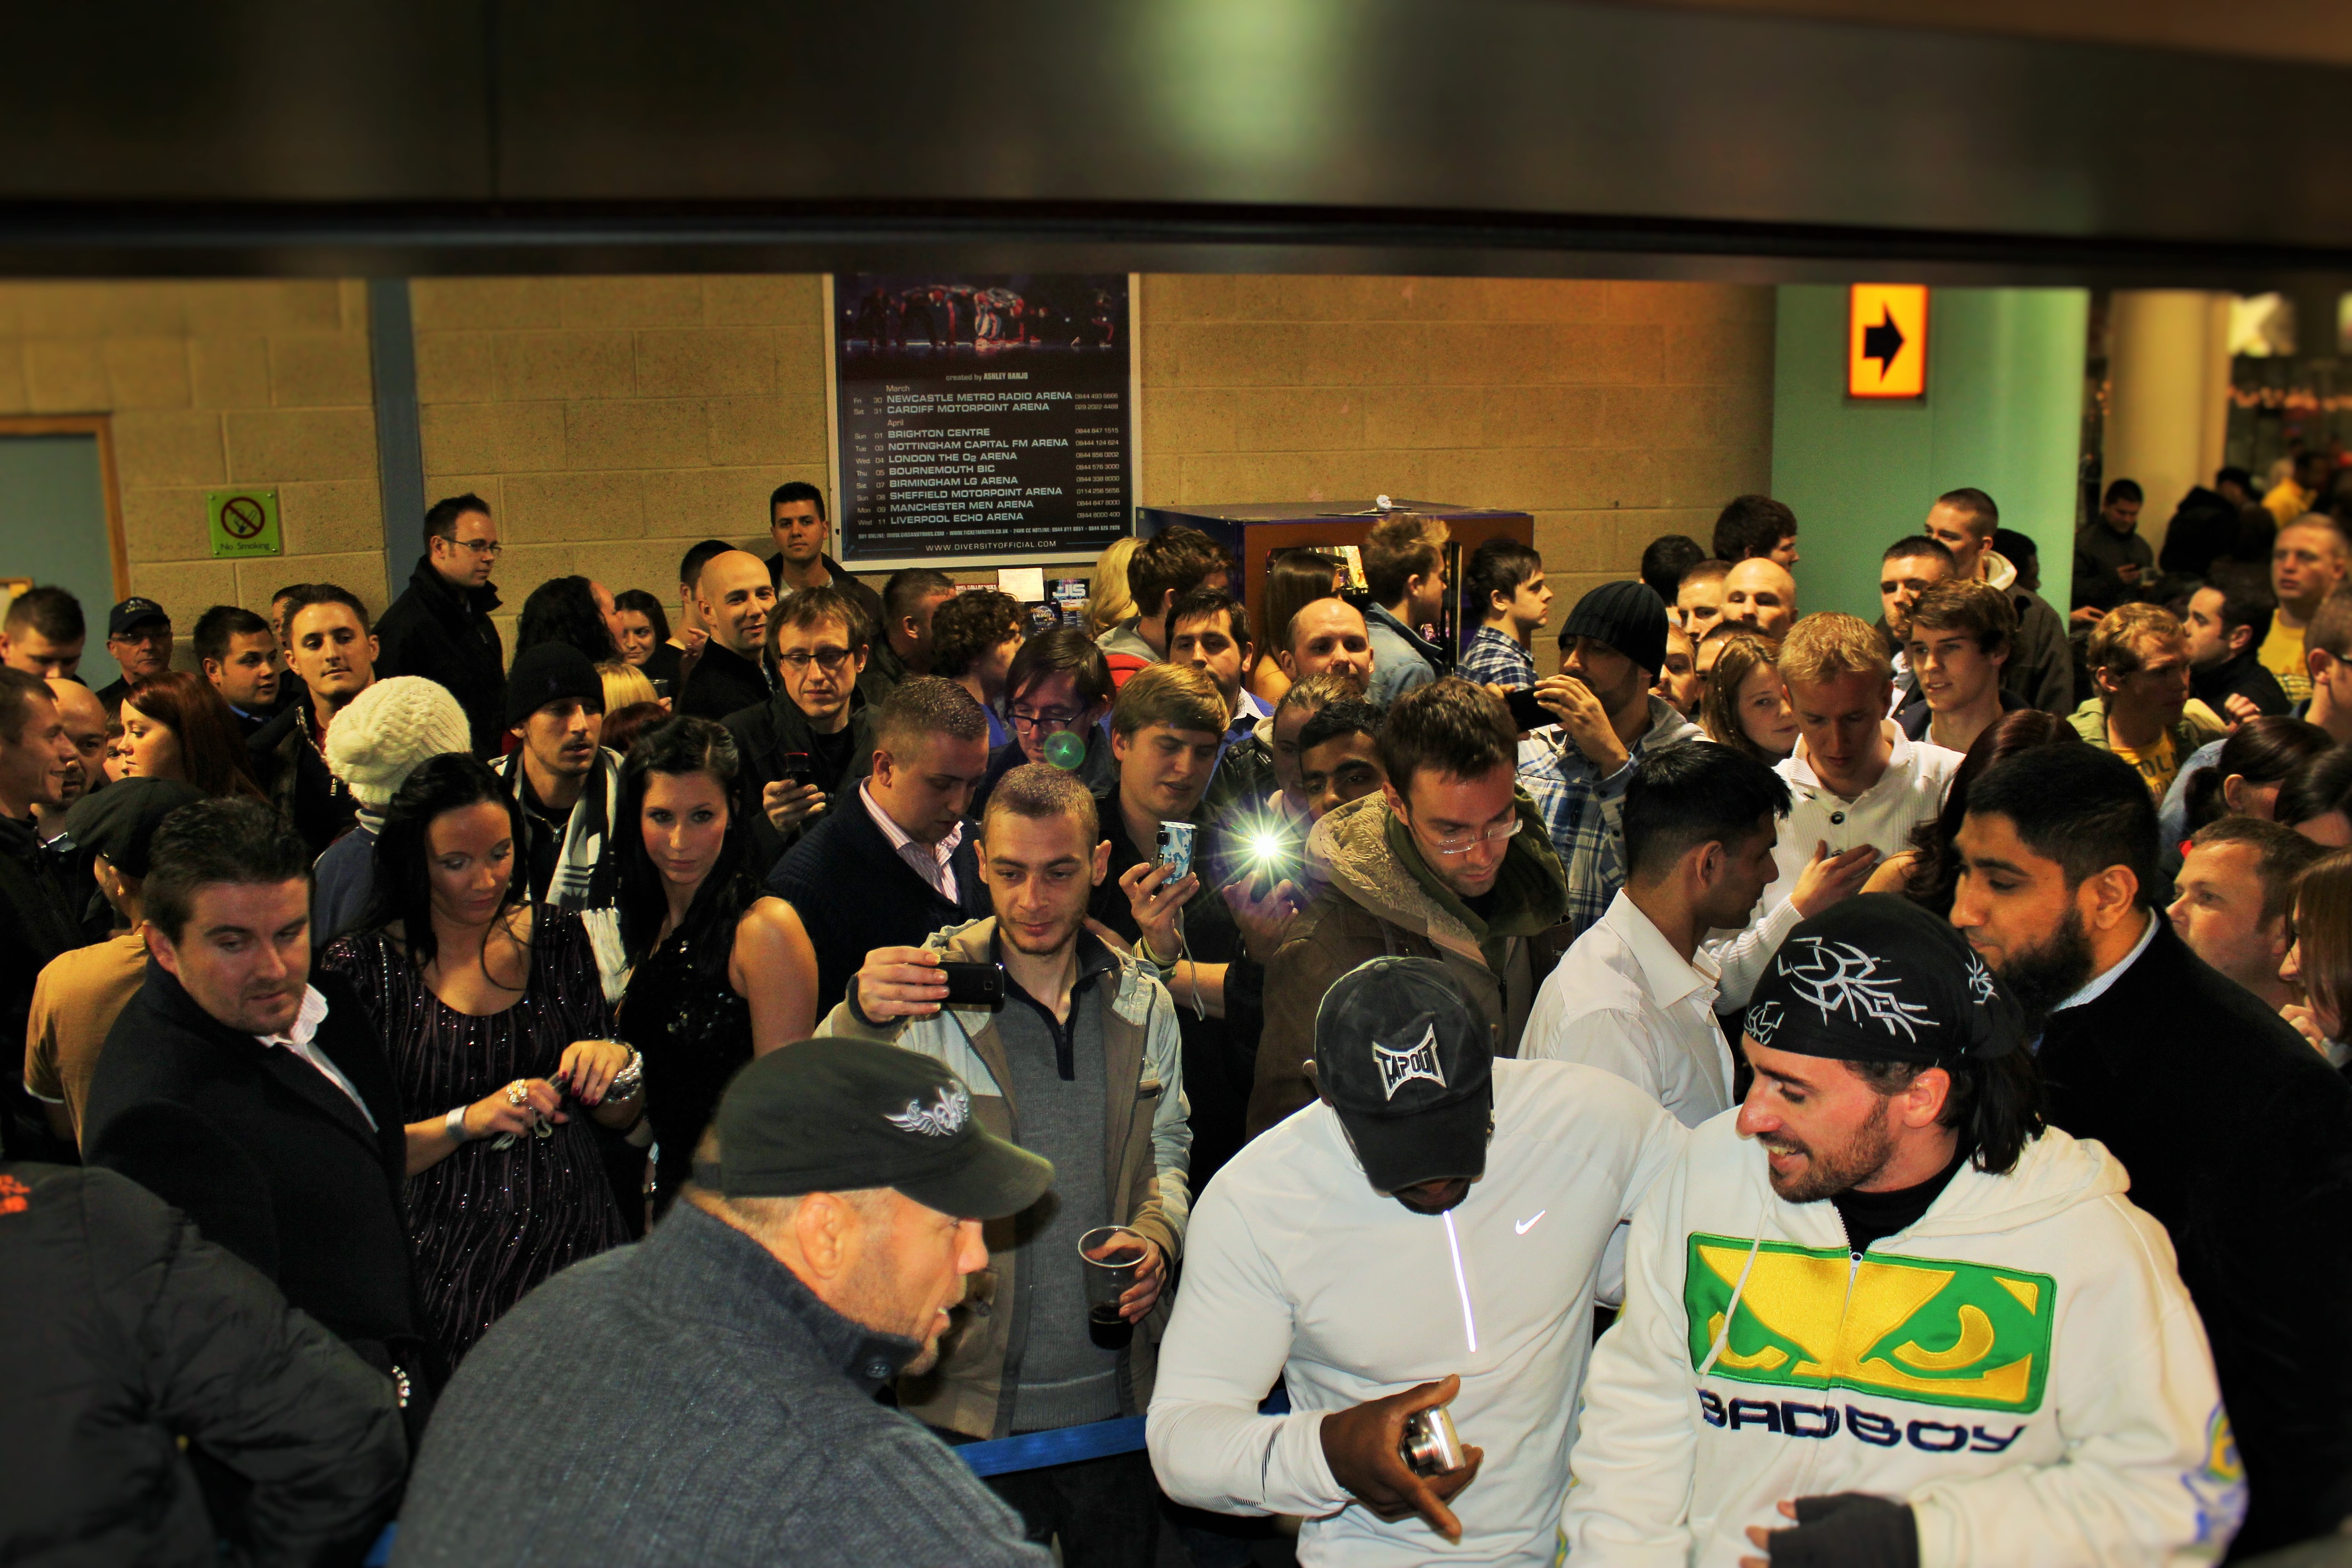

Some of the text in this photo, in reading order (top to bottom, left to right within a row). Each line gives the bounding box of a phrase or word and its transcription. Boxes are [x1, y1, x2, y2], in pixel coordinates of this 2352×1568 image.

[887, 394, 953, 403] NEWCASTLE
[957, 392, 995, 402] METRO
[999, 392, 1032, 401] RADIO
[1035, 392, 1073, 400] ARENA
[887, 405, 934, 414] CARDIFF
[937, 403, 1009, 413] MOTORPOINT
[887, 419, 903, 427] April
[888, 430, 944, 438] BRIGHTON
[947, 428, 990, 436] CENTRE
[888, 441, 960, 451] NOTTINGHAM
[965, 440, 1009, 449] CAPITAL
[1031, 439, 1068, 447] ARENA
[889, 454, 935, 463] LONDON
[980, 452, 1017, 461] ARENA
[889, 466, 974, 475] BOURNEMOUTH
[977, 465, 995, 473] BIC
[889, 478, 960, 488] BIRMINGHAM
[981, 476, 1018, 485] ARENA
[890, 490, 948, 500] SHEFFIELD
[951, 488, 1022, 498] MOTORPOINT
[1025, 487, 1063, 495] ARENA
[890, 502, 965, 512] MANCHESTER
[969, 501, 993, 510] MEN
[891, 515, 950, 524] LIVERPOOL
[953, 514, 983, 522] ECHO
[986, 513, 1024, 521] ARENA
[237, 542, 270, 551] Smoking
[926, 541, 1056, 551] WWW.DIVERSITYOFFICIAL.COM
[1053, 583, 1086, 597] JLS
[1376, 1037, 1439, 1090] TAPOUT
